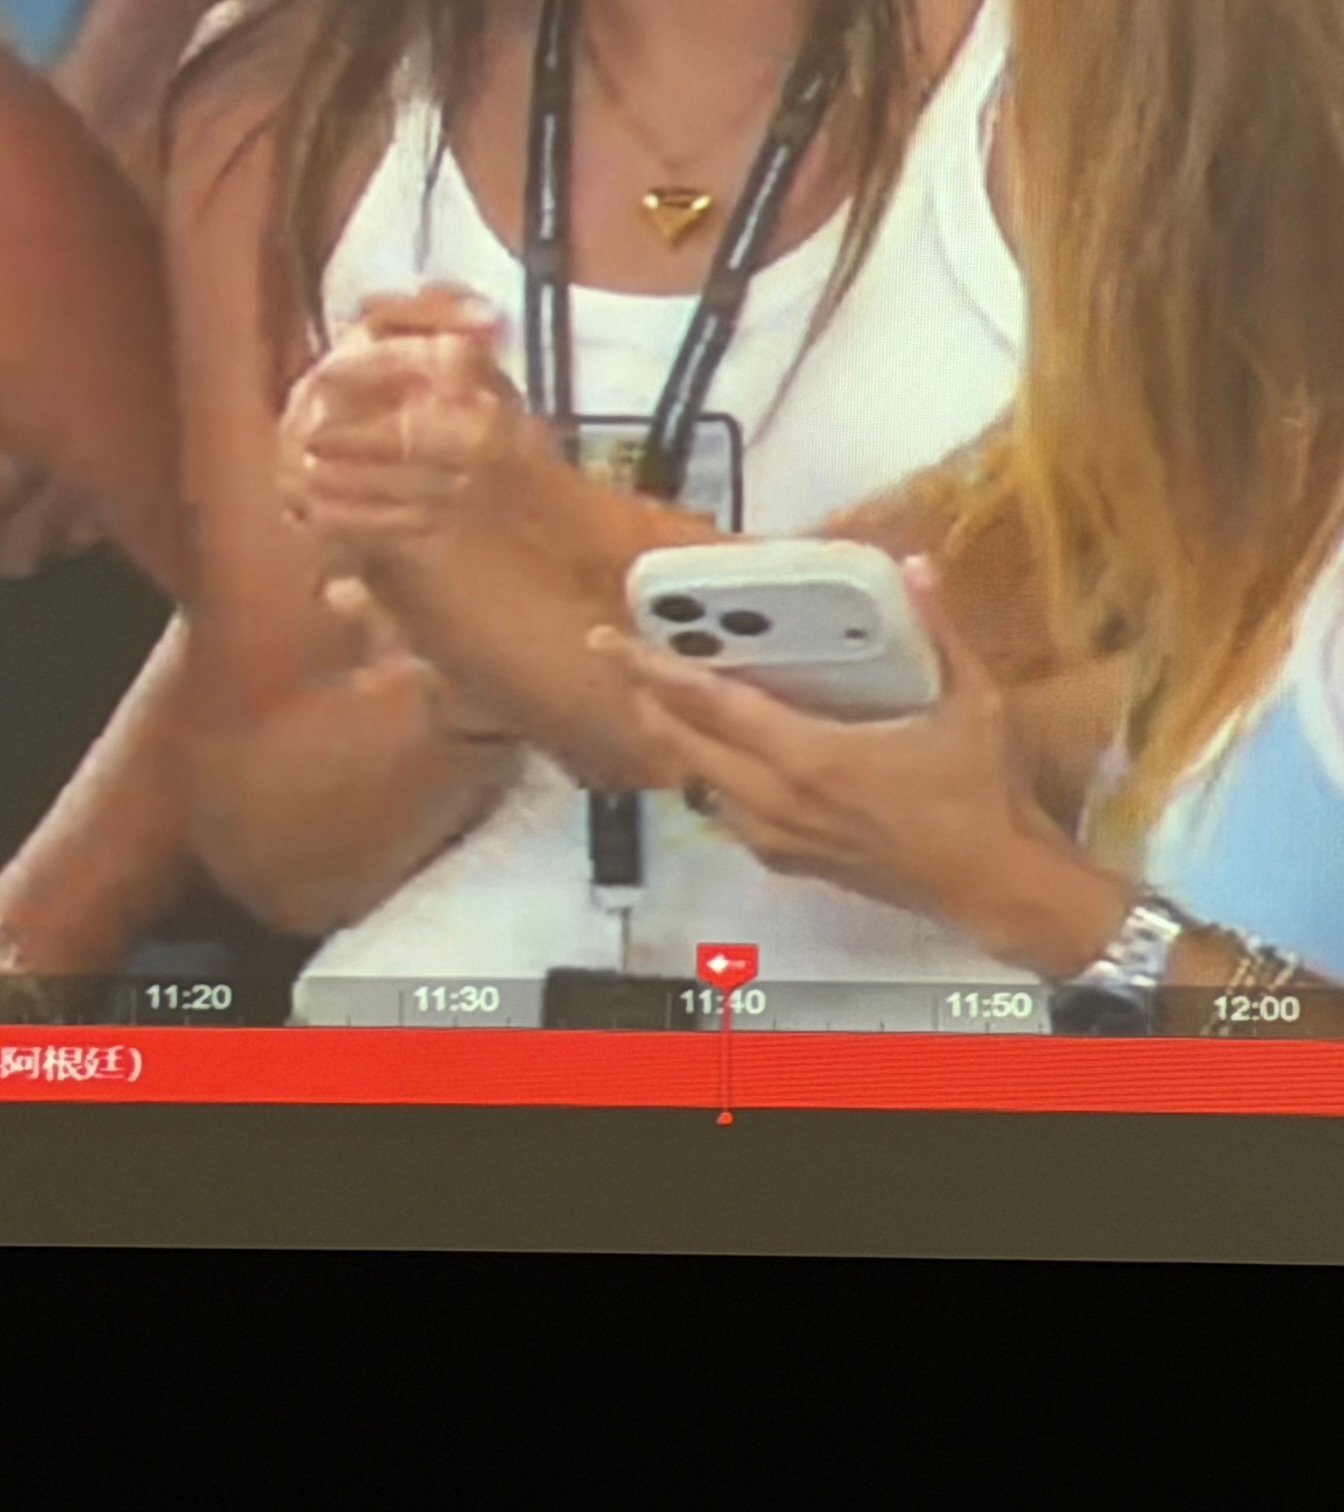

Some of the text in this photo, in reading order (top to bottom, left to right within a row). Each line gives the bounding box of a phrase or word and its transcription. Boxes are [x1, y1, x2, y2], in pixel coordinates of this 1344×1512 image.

[145, 983, 232, 1012] 11:20
[413, 985, 500, 1013] 11:30
[679, 988, 766, 1015] 11:40
[945, 990, 1033, 1018] 11:50
[1213, 996, 1301, 1023] 12:00
